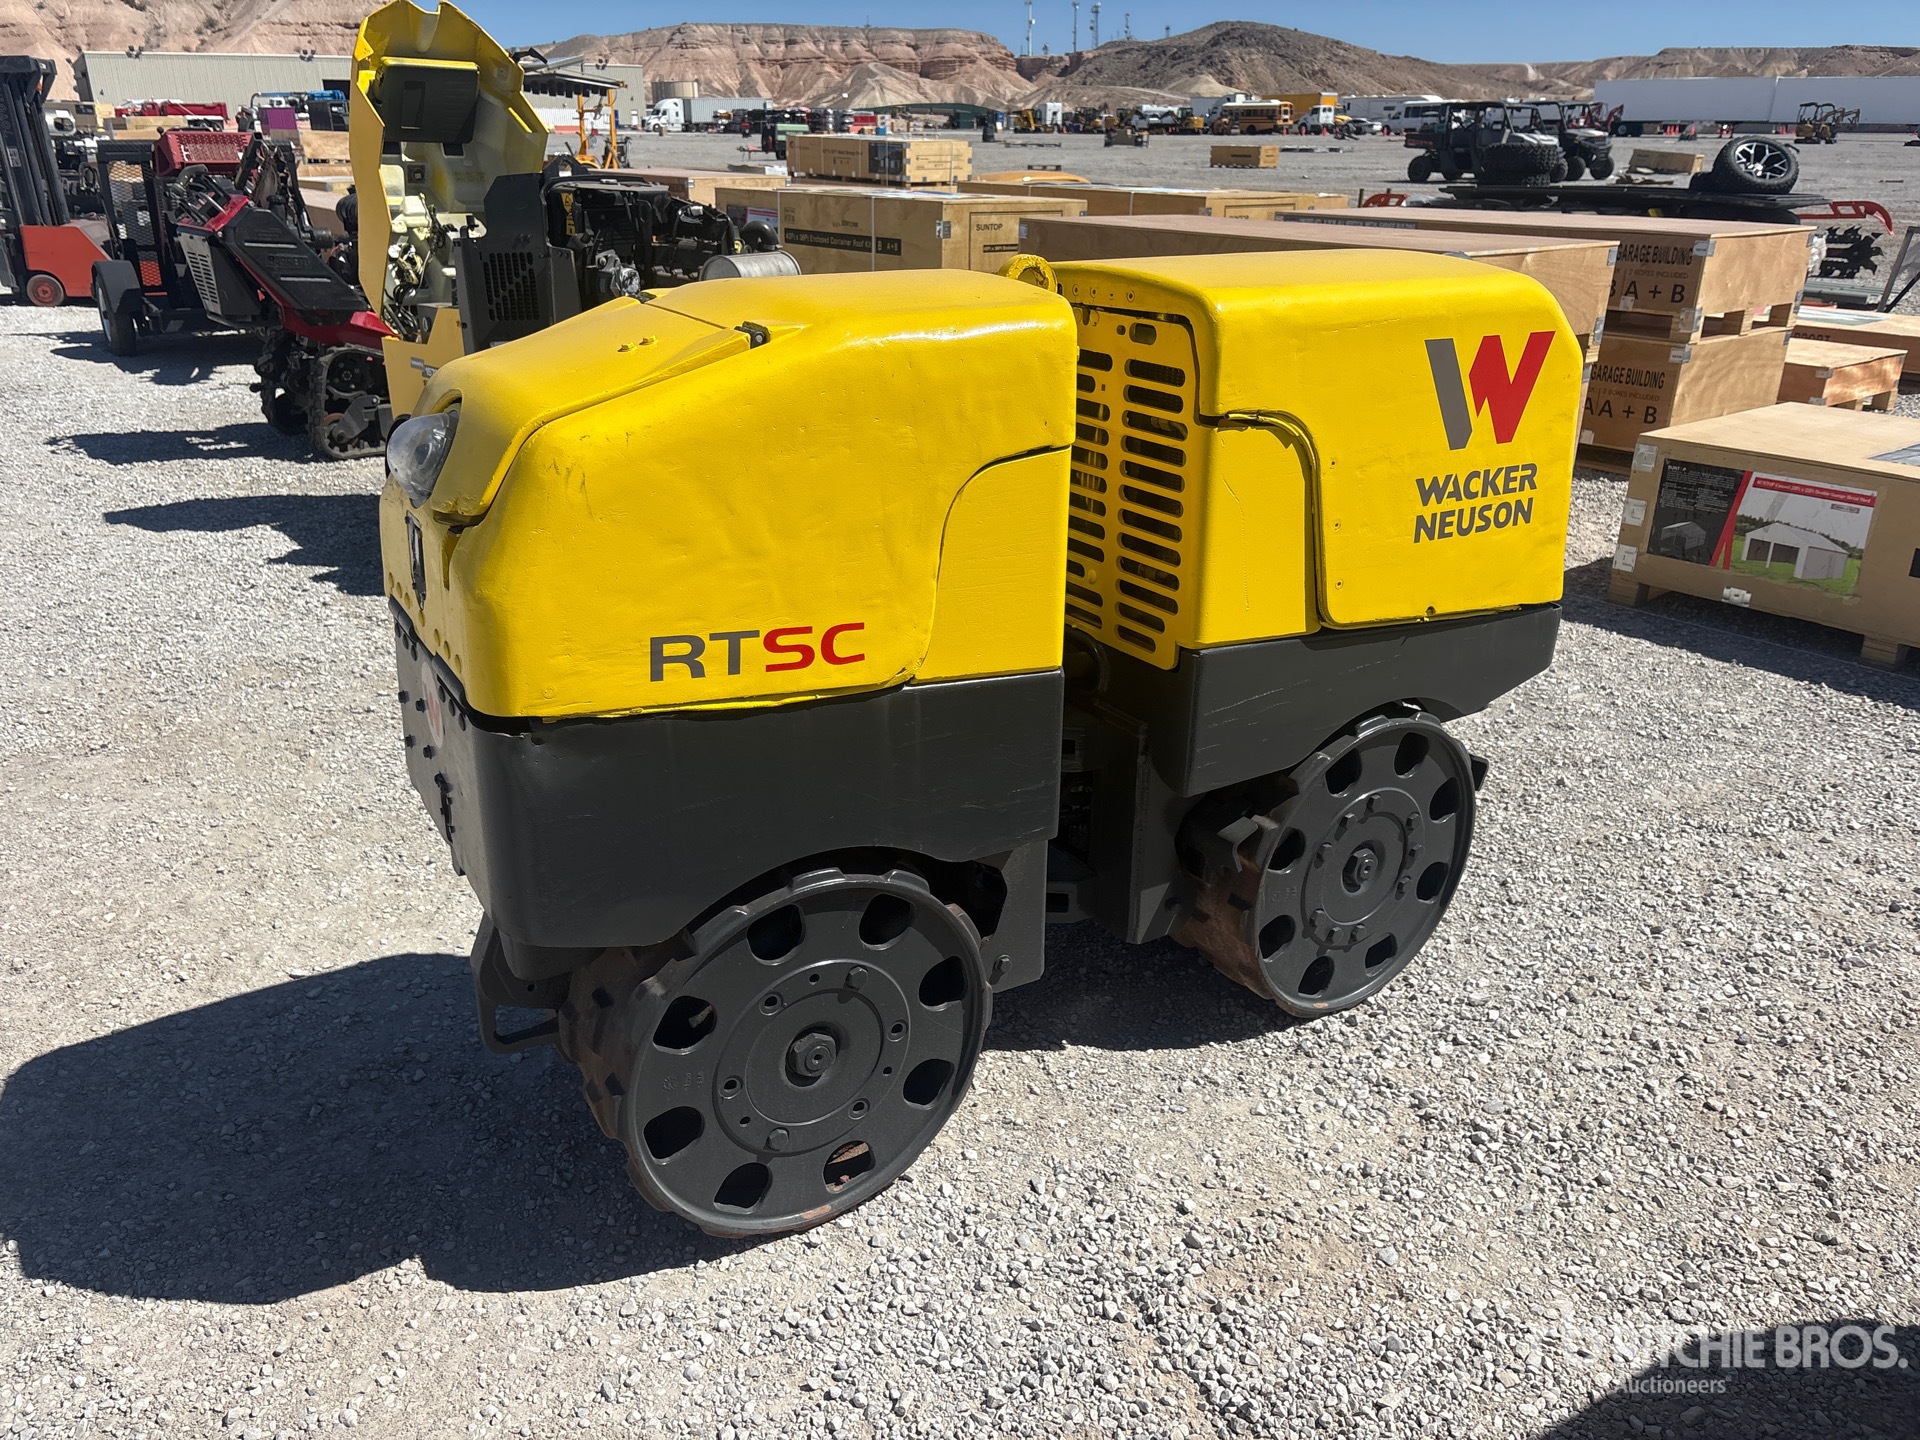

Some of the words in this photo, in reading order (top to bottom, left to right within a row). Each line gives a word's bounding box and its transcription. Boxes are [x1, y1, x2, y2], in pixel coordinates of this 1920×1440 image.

[976, 223, 1003, 231] SUNTOP
[1617, 243, 1652, 263] GARAGE
[1652, 245, 1693, 266] BUILDING
[1656, 271, 1689, 279] INCLUDED
[1624, 280, 1639, 301] A
[1671, 284, 1685, 303] B
[1591, 364, 1625, 384] GARAGE
[1625, 368, 1665, 389] BUILDING
[1629, 391, 1660, 402] INCLUDED
[1598, 400, 1613, 418] A
[1643, 405, 1657, 424] B
[1416, 463, 1537, 507] WACKER
[1414, 497, 1534, 543] NEUSON
[650, 622, 865, 682] RTSC
